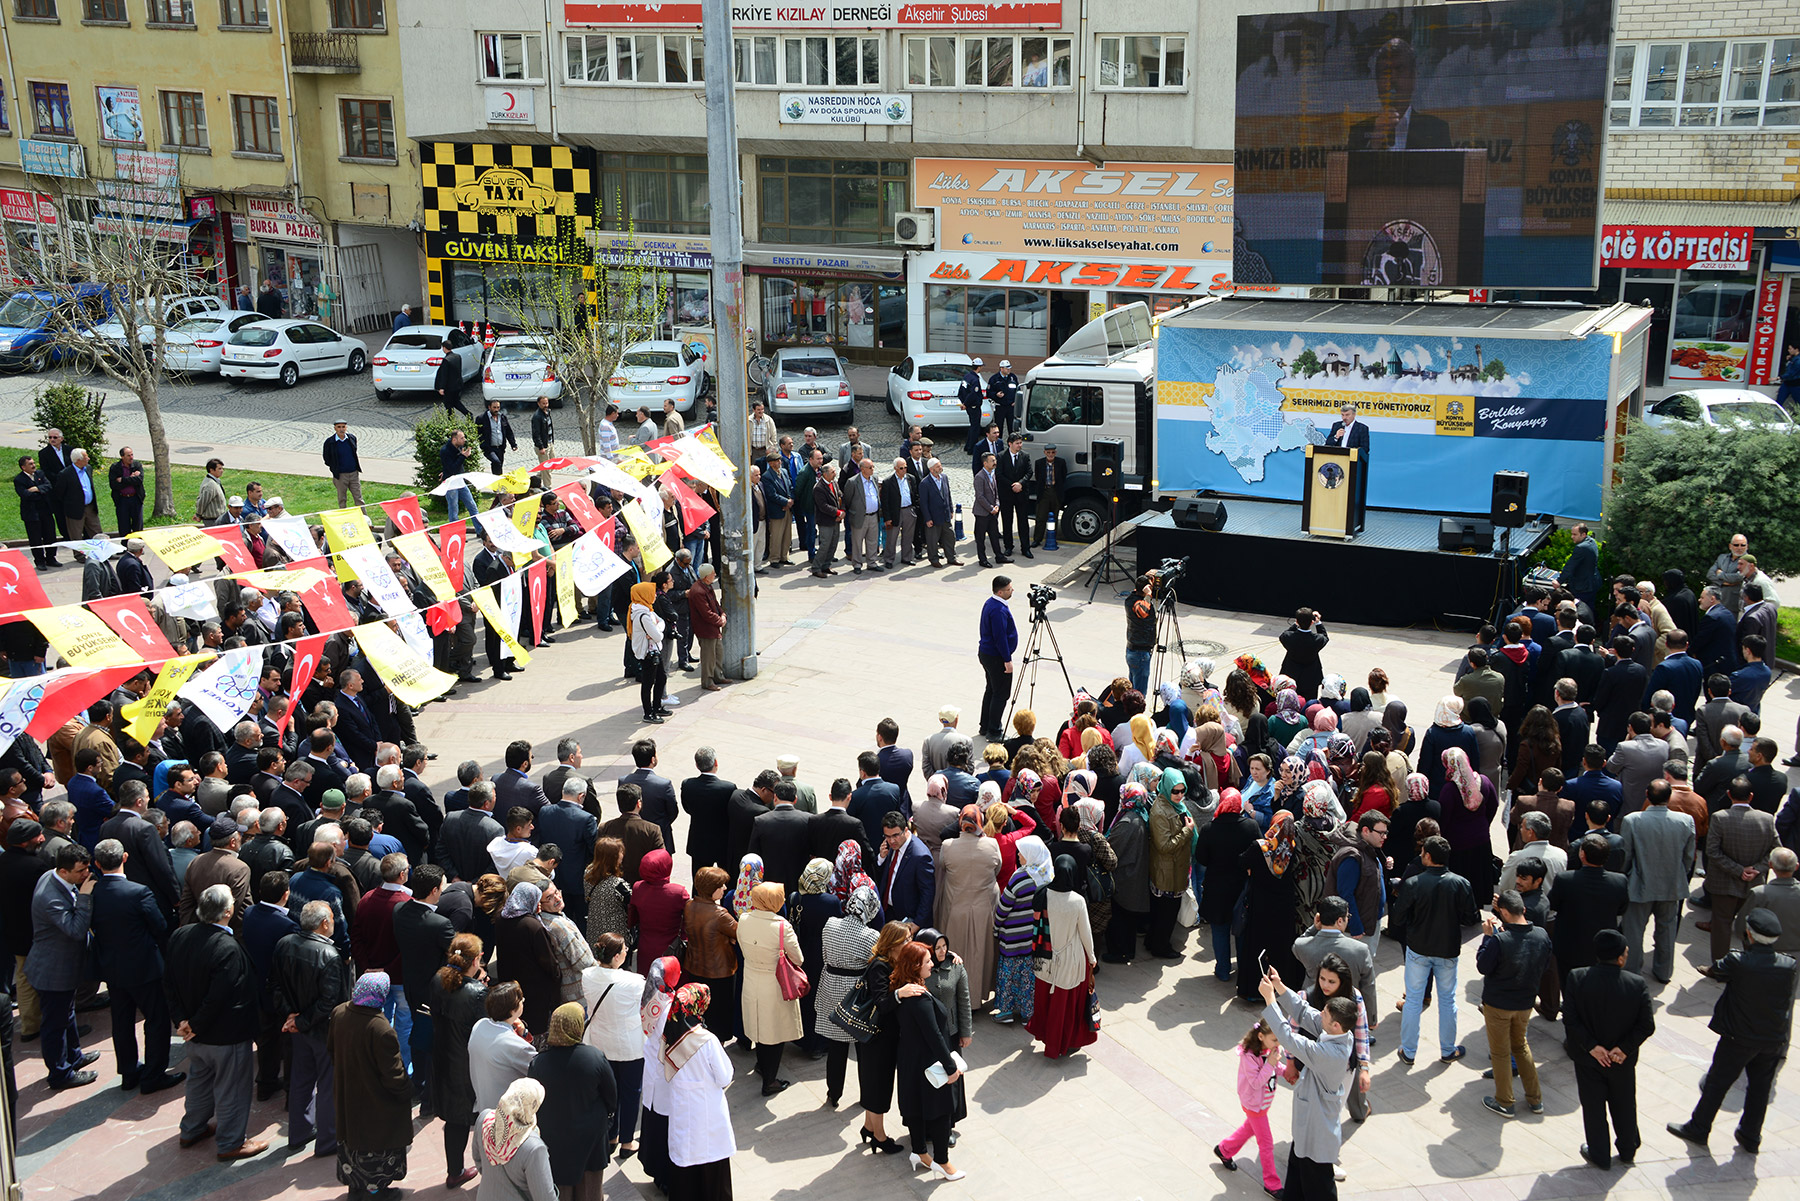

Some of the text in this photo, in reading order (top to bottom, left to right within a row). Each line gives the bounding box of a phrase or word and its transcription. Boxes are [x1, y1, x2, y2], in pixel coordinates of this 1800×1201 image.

[732, 4, 989, 24] RKİYE KIZILAY DERNEĞİ Akşehir Şubesi
[808, 96, 882, 106] NASREDDİN HOCA
[830, 115, 861, 123] KULÜBÜ
[928, 171, 970, 190] Lüks
[977, 168, 1206, 197] AKSEL
[1549, 168, 1593, 184] KONYA
[249, 199, 279, 213] HAVLU
[967, 197, 997, 207] ESKİŞEHİR
[1026, 199, 1049, 207] BİLECİK
[1054, 201, 1089, 209] ADAPAZARI
[1094, 201, 1120, 209] KOCAELİ
[1125, 202, 1145, 210] GEBZE
[1150, 202, 1181, 211] İSTANBUL
[959, 209, 979, 217] AFYON
[984, 209, 1001, 219] UŞAK
[1028, 211, 1052, 219] MANİSA
[1057, 211, 1081, 220] DENİZLİ
[1113, 213, 1133, 221] AYDIN
[1138, 213, 1156, 222] SÖKE
[1161, 214, 1181, 222] MİLAS
[1186, 215, 1216, 223] BODRUM
[250, 219, 279, 234] BURSA
[1023, 222, 1180, 234] MARMARİS ISPARTA ANTALYA POLATLI ANKARA
[445, 237, 509, 259] GÜVEN
[1023, 238, 1179, 252] www.lüksakselseyahat.com
[1601, 229, 1749, 266] ÇİĞ KÖFTECİSİ
[817, 258, 849, 268] PAZARI
[929, 261, 970, 279] Lüks
[979, 258, 1202, 289] AKSEL
[1292, 398, 1332, 408] ŞEHRİMİZİ
[1372, 400, 1431, 412] YÖNETİYORUZ
[1478, 405, 1526, 420] Birlikte
[1490, 416, 1549, 431] Konyayız
